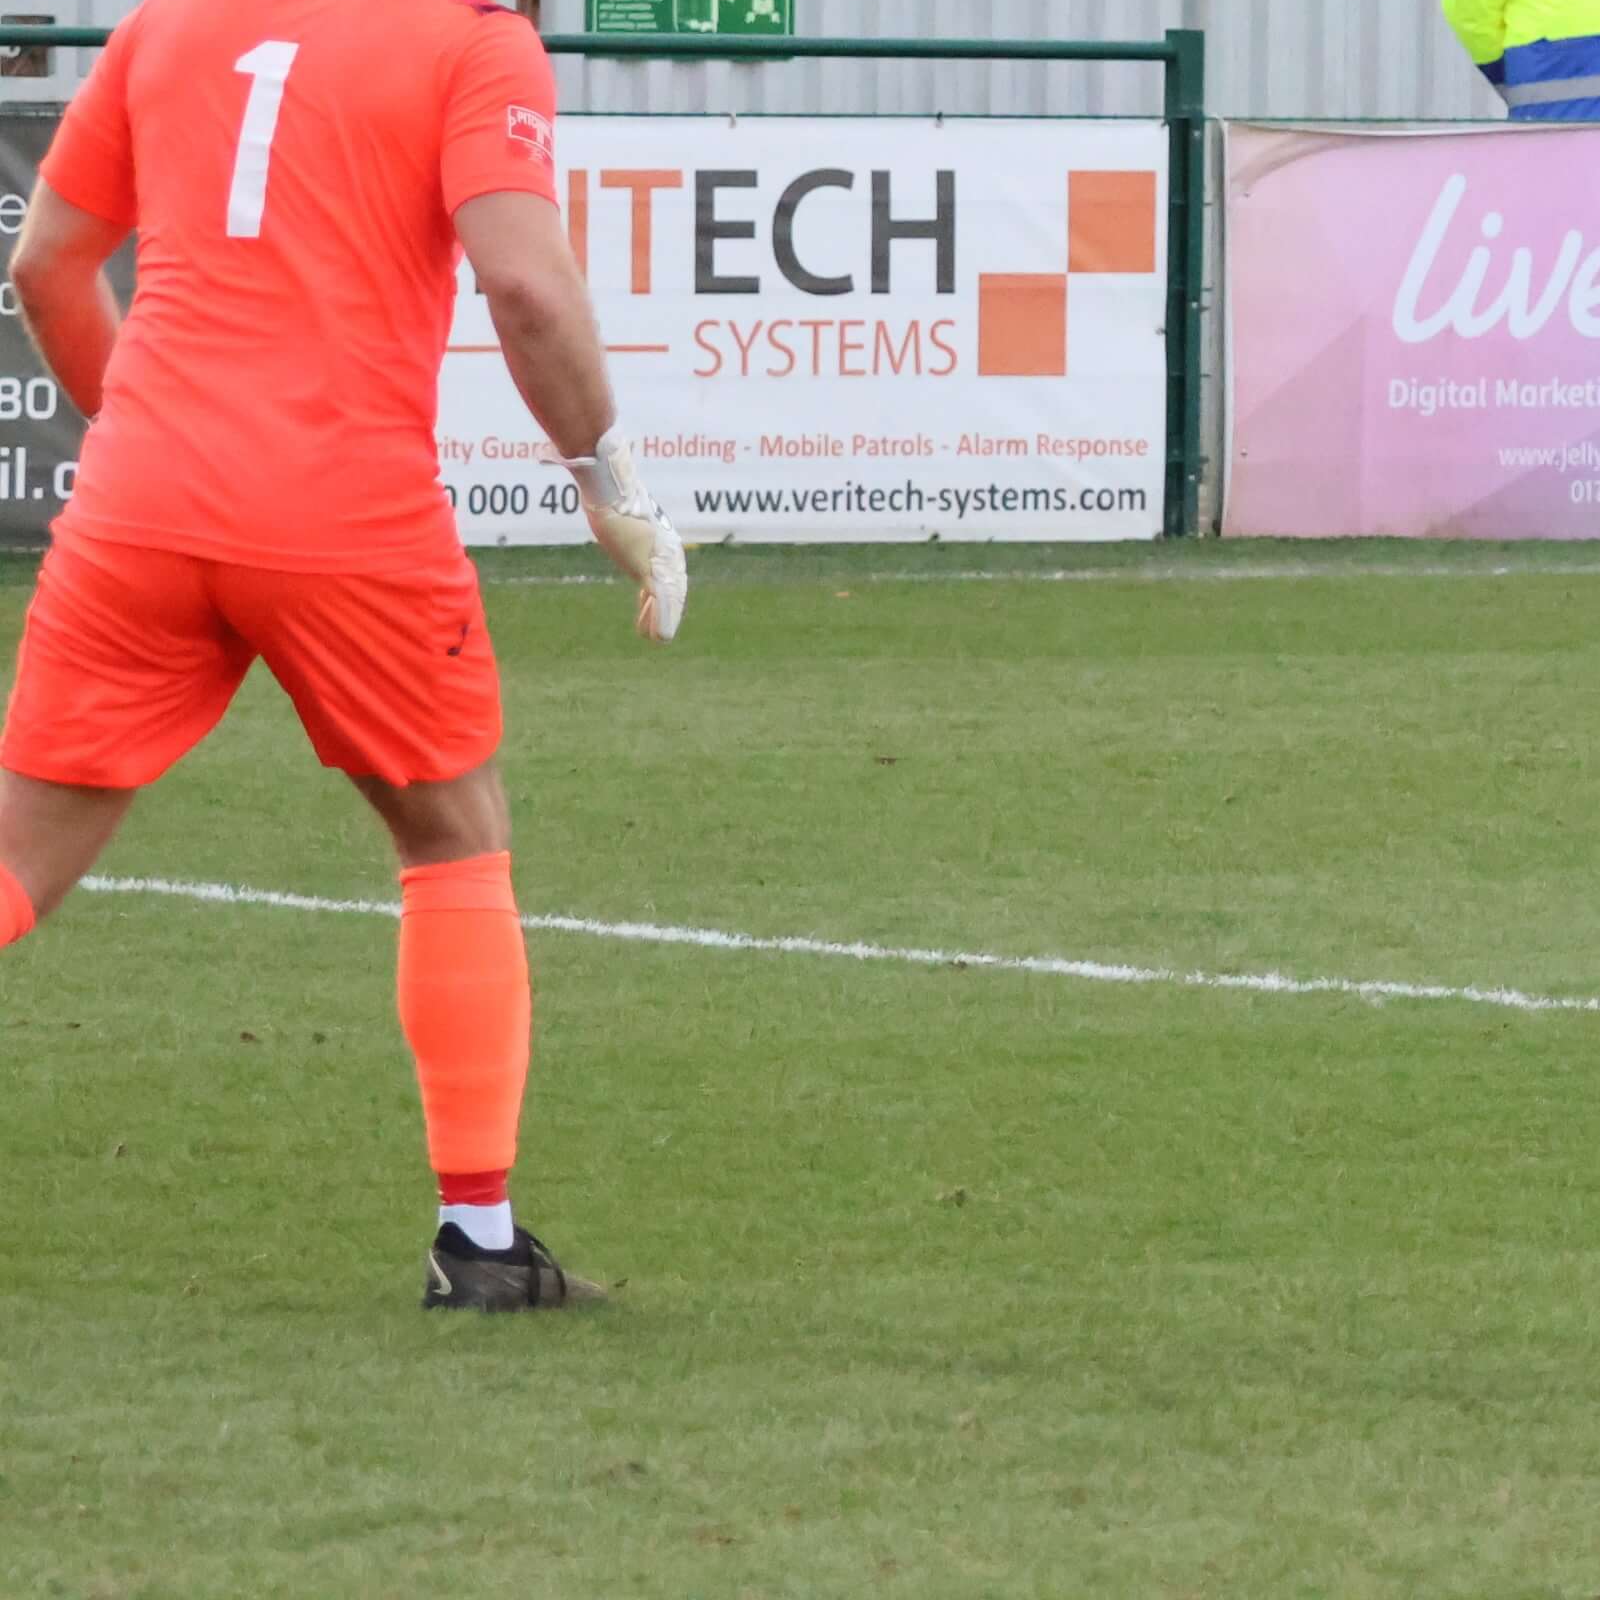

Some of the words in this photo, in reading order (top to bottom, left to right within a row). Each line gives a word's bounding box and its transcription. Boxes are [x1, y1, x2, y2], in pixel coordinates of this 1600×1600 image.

[226, 39, 299, 238] 1
[568, 167, 956, 296] ITECH
[692, 318, 958, 379] SYSTEMS
[1388, 378, 1488, 416] Digital
[642, 434, 737, 464] Holding
[759, 433, 844, 458] Mobile
[851, 433, 934, 458] Patrols
[956, 432, 1029, 458] Alarm
[1036, 432, 1149, 462] Response
[468, 483, 529, 515] 000
[694, 480, 1148, 519] www.veritech-systems.com
